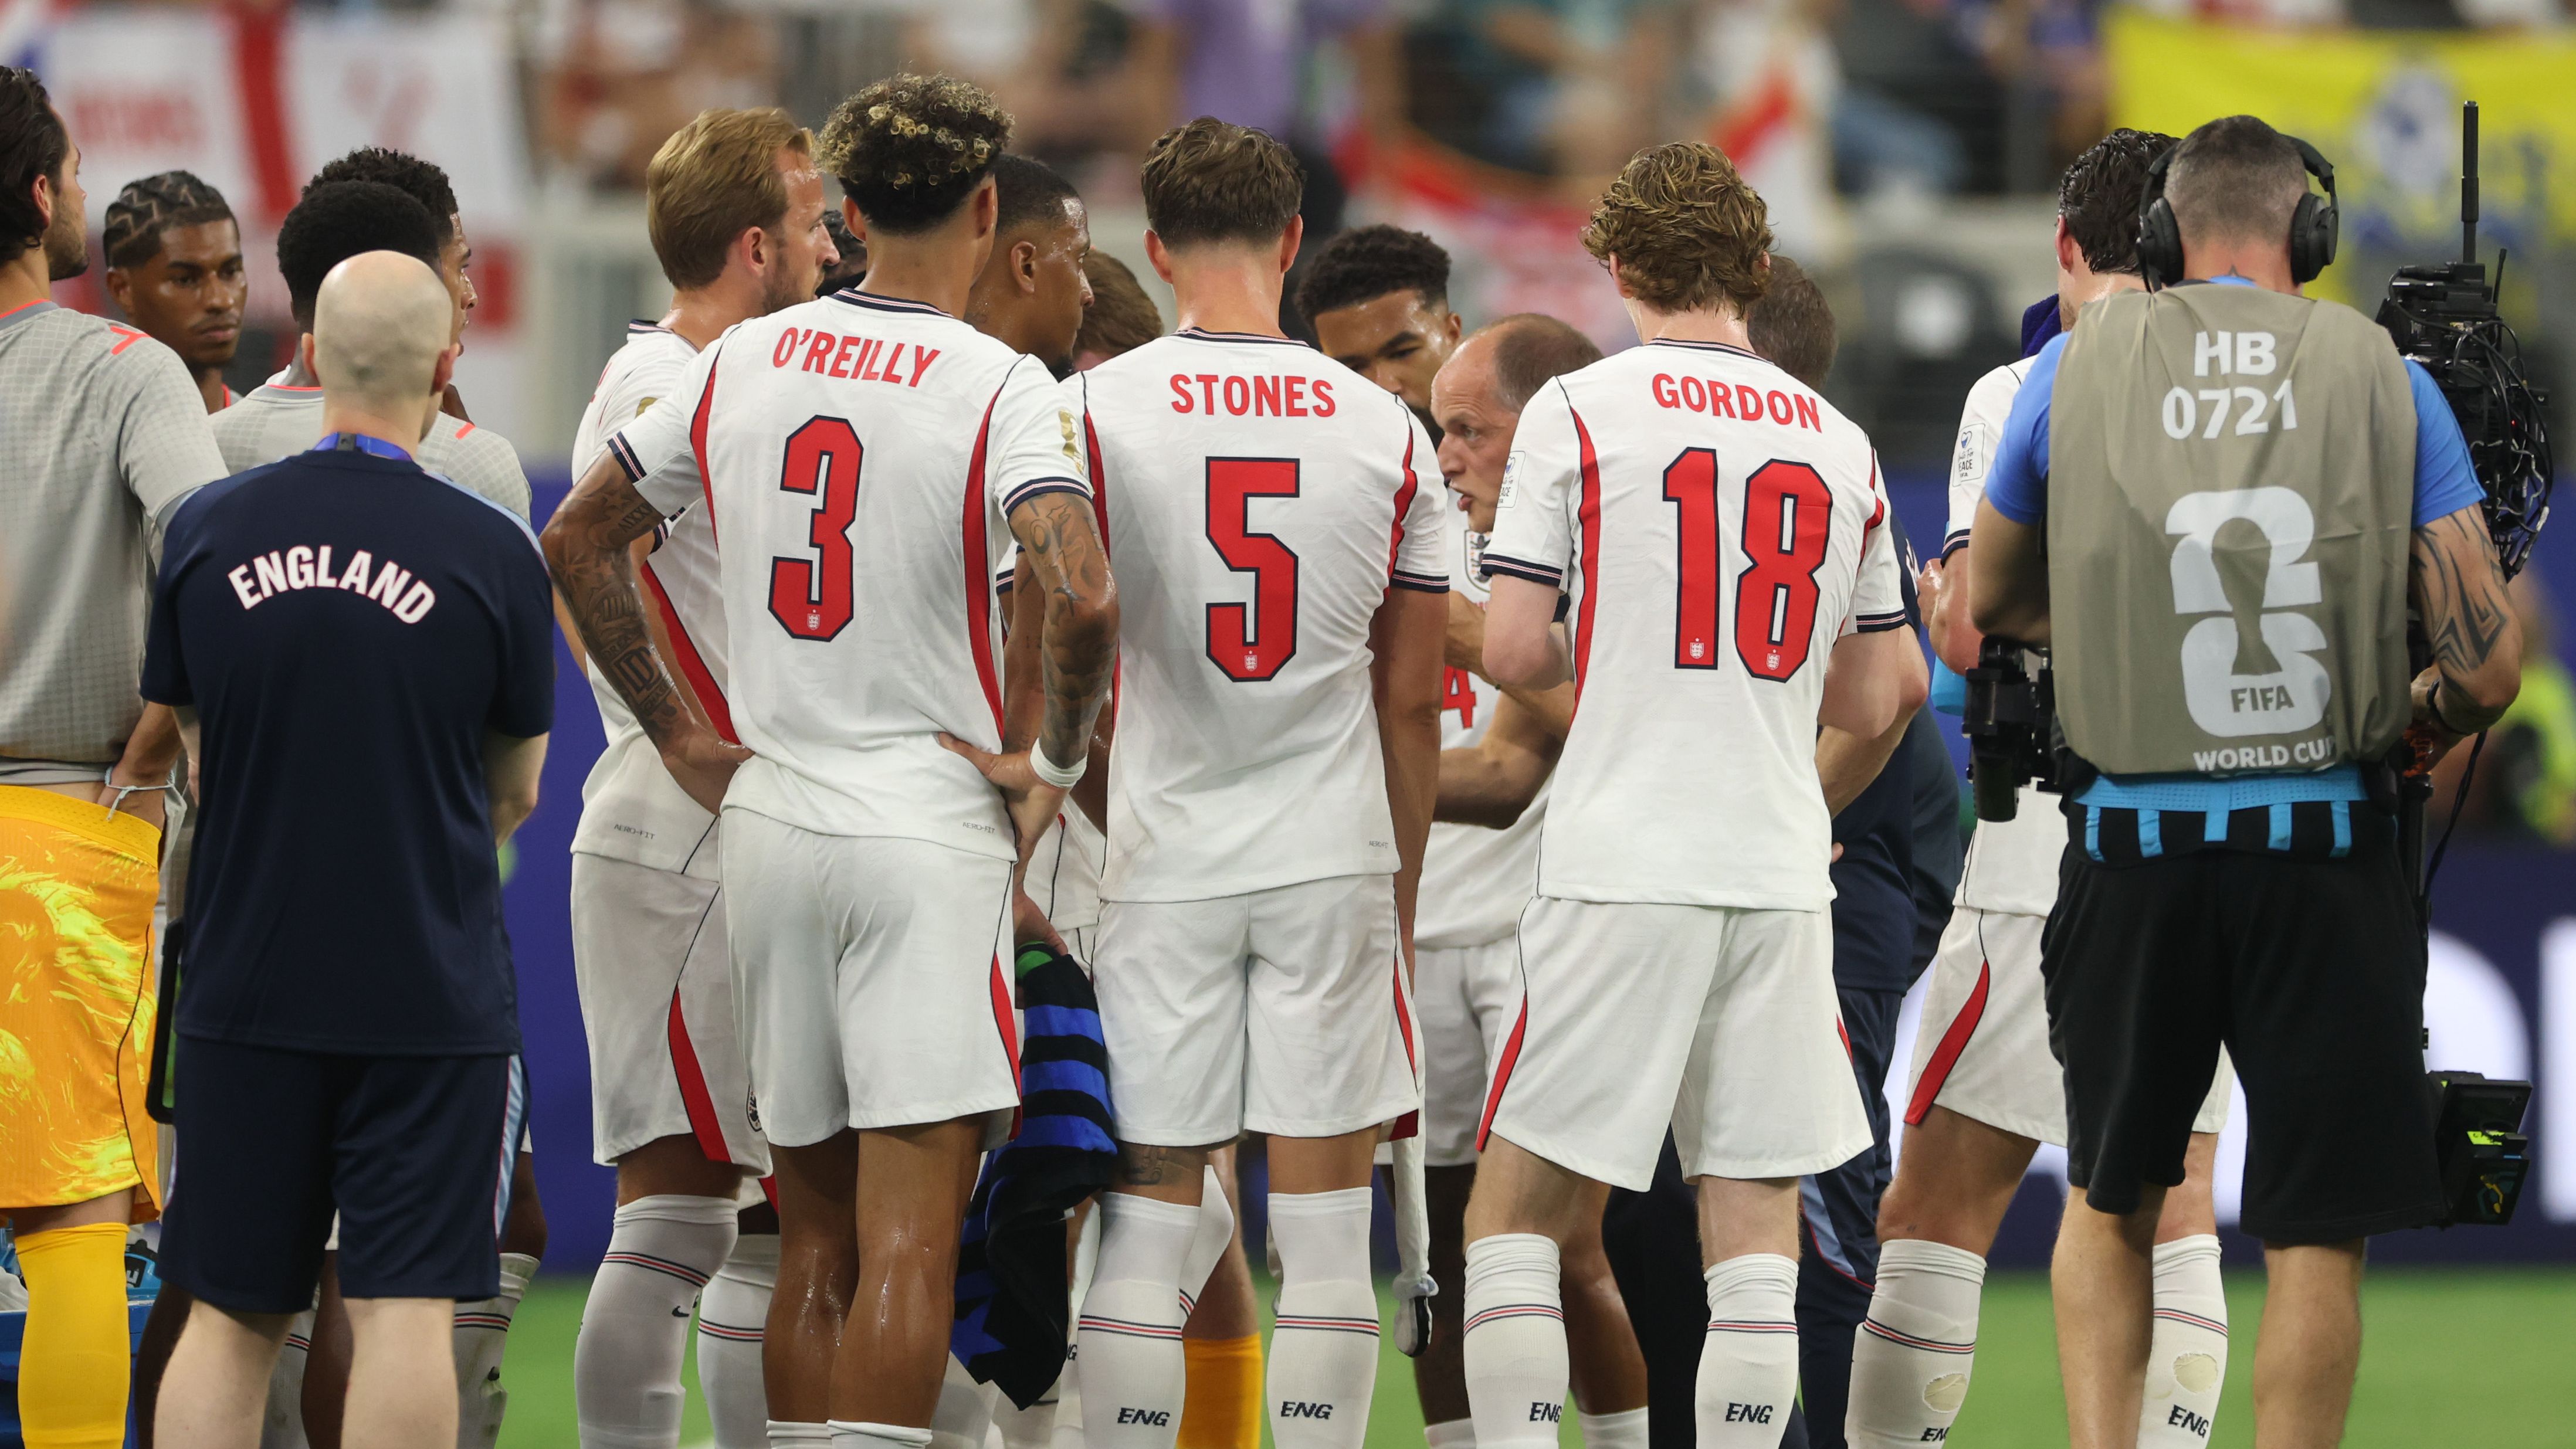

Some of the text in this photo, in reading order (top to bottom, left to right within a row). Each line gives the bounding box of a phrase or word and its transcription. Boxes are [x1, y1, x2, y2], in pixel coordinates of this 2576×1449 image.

[772, 327, 941, 388] O'REILLY
[2194, 331, 2277, 376] HB
[1170, 373, 1337, 418] STONES
[1652, 372, 1822, 433] GORDON
[2161, 379, 2298, 440] 0721
[767, 414, 865, 643] 3
[228, 545, 435, 624] ENGLAND
[1205, 456, 1301, 683] 5
[1662, 446, 1833, 684] 18
[2230, 684, 2295, 713] FIFA
[2192, 745, 2290, 772] WORLD
[1117, 1407, 1171, 1427] ENG
[1280, 1401, 1334, 1420] ENG
[1529, 1402, 1562, 1424] ENG
[1725, 1402, 1774, 1424] ENG
[2168, 1404, 2209, 1438] ENG
